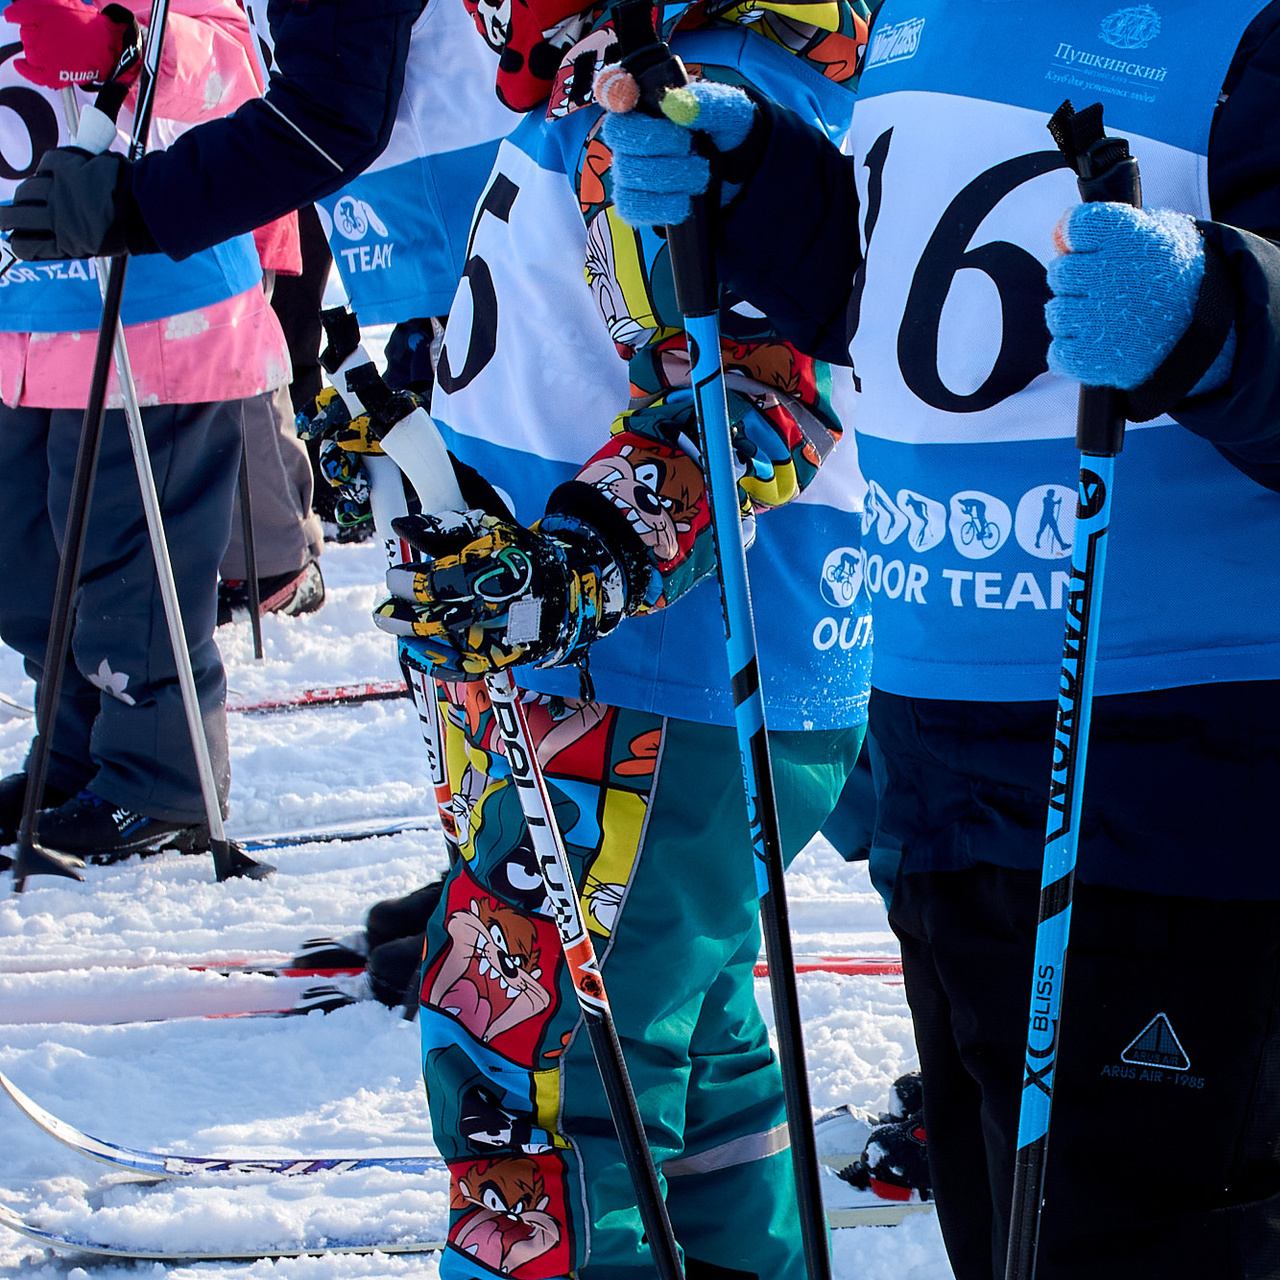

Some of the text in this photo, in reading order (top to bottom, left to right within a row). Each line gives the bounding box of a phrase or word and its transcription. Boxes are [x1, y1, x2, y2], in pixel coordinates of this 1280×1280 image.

[59, 70, 100, 82] reima
[1053, 42, 1168, 82] Пушкинский
[340, 243, 394, 274] TEAM
[1033, 964, 1055, 1032] BLISS
[1100, 1065, 1136, 1079] ARUS
[1139, 1068, 1163, 1083] AIR
